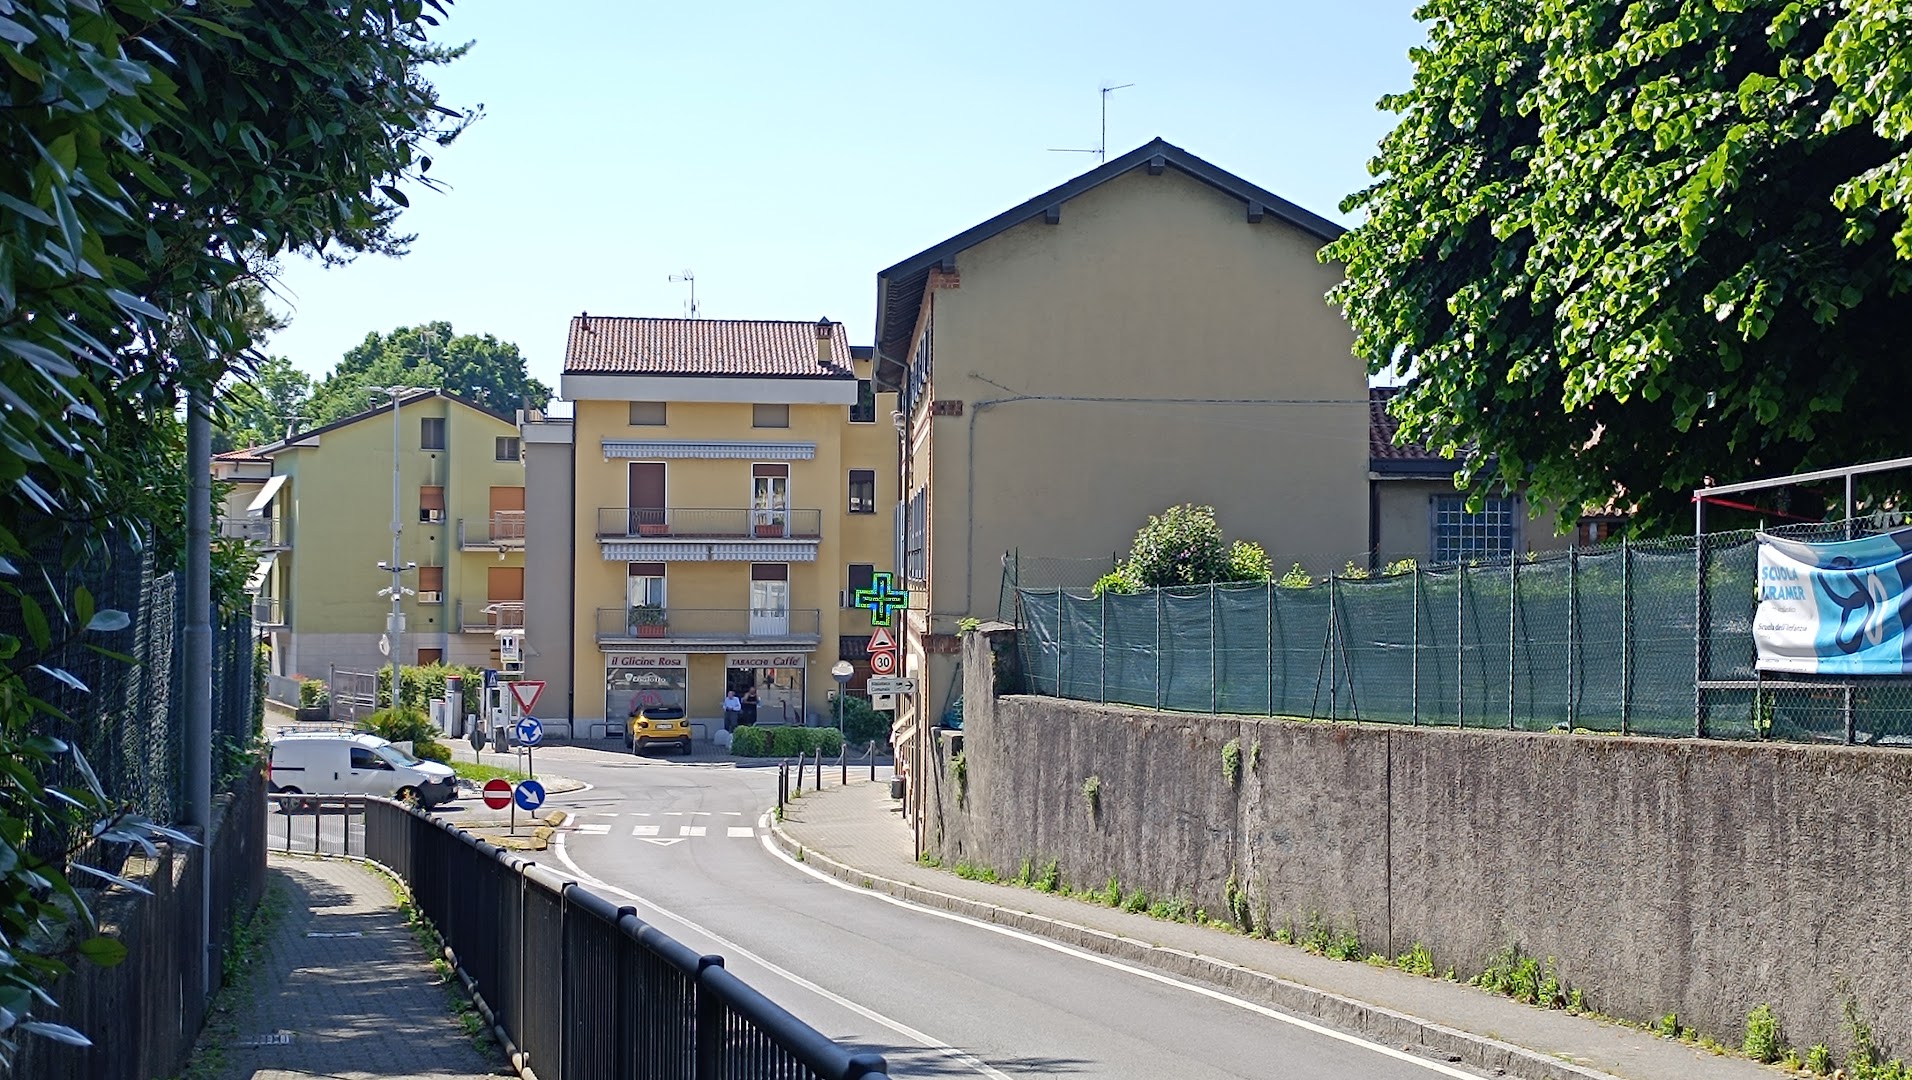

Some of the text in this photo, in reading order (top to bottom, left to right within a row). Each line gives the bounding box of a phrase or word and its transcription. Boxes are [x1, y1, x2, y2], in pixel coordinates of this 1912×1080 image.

[1762, 566, 1799, 581] SCUOLA
[611, 656, 681, 666] il Glicine Rosa
[878, 657, 889, 668] 30
